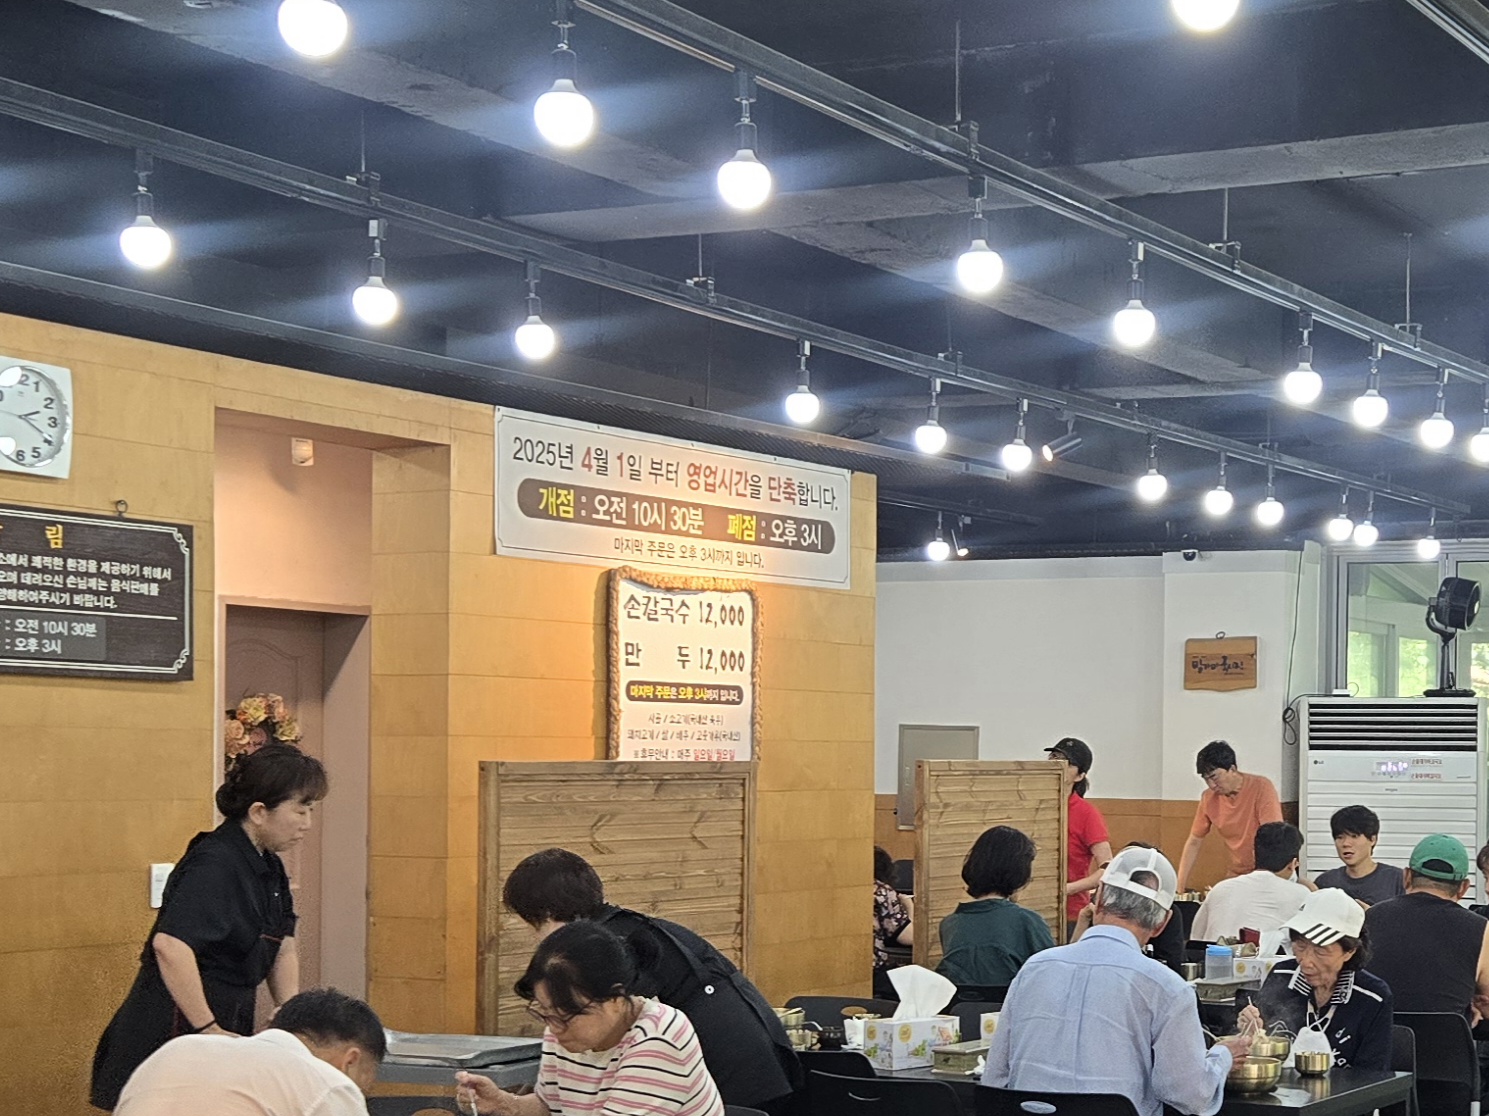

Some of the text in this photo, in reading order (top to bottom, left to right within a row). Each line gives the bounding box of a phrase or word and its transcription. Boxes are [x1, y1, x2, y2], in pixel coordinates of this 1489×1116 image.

[43, 397, 55, 410] 2
[47, 416, 58, 429] 3
[16, 449, 26, 462] 6
[31, 446, 41, 459] 5
[513, 436, 839, 512] 2025년 4월 1일 부터 영업시간을 단축합니다.
[538, 486, 575, 519] 개점
[580, 495, 587, 517] :
[592, 494, 627, 525] 오전
[632, 501, 666, 531] 10시
[670, 505, 705, 535] 30분
[727, 513, 757, 542] 폐점
[769, 519, 798, 547] 오후
[800, 523, 822, 550] 3시
[614, 536, 765, 569] 마지막 주문은 오후 3시까지 입니다.
[100, 561, 140, 578] 제공하기
[623, 593, 745, 629] 손칼국수 12,000
[14, 618, 39, 634] 오전
[42, 620, 69, 636] 10시
[71, 621, 98, 638] 30분
[14, 637, 40, 653] 오후
[41, 638, 62, 654] 3시
[699, 646, 745, 675] 12,000
